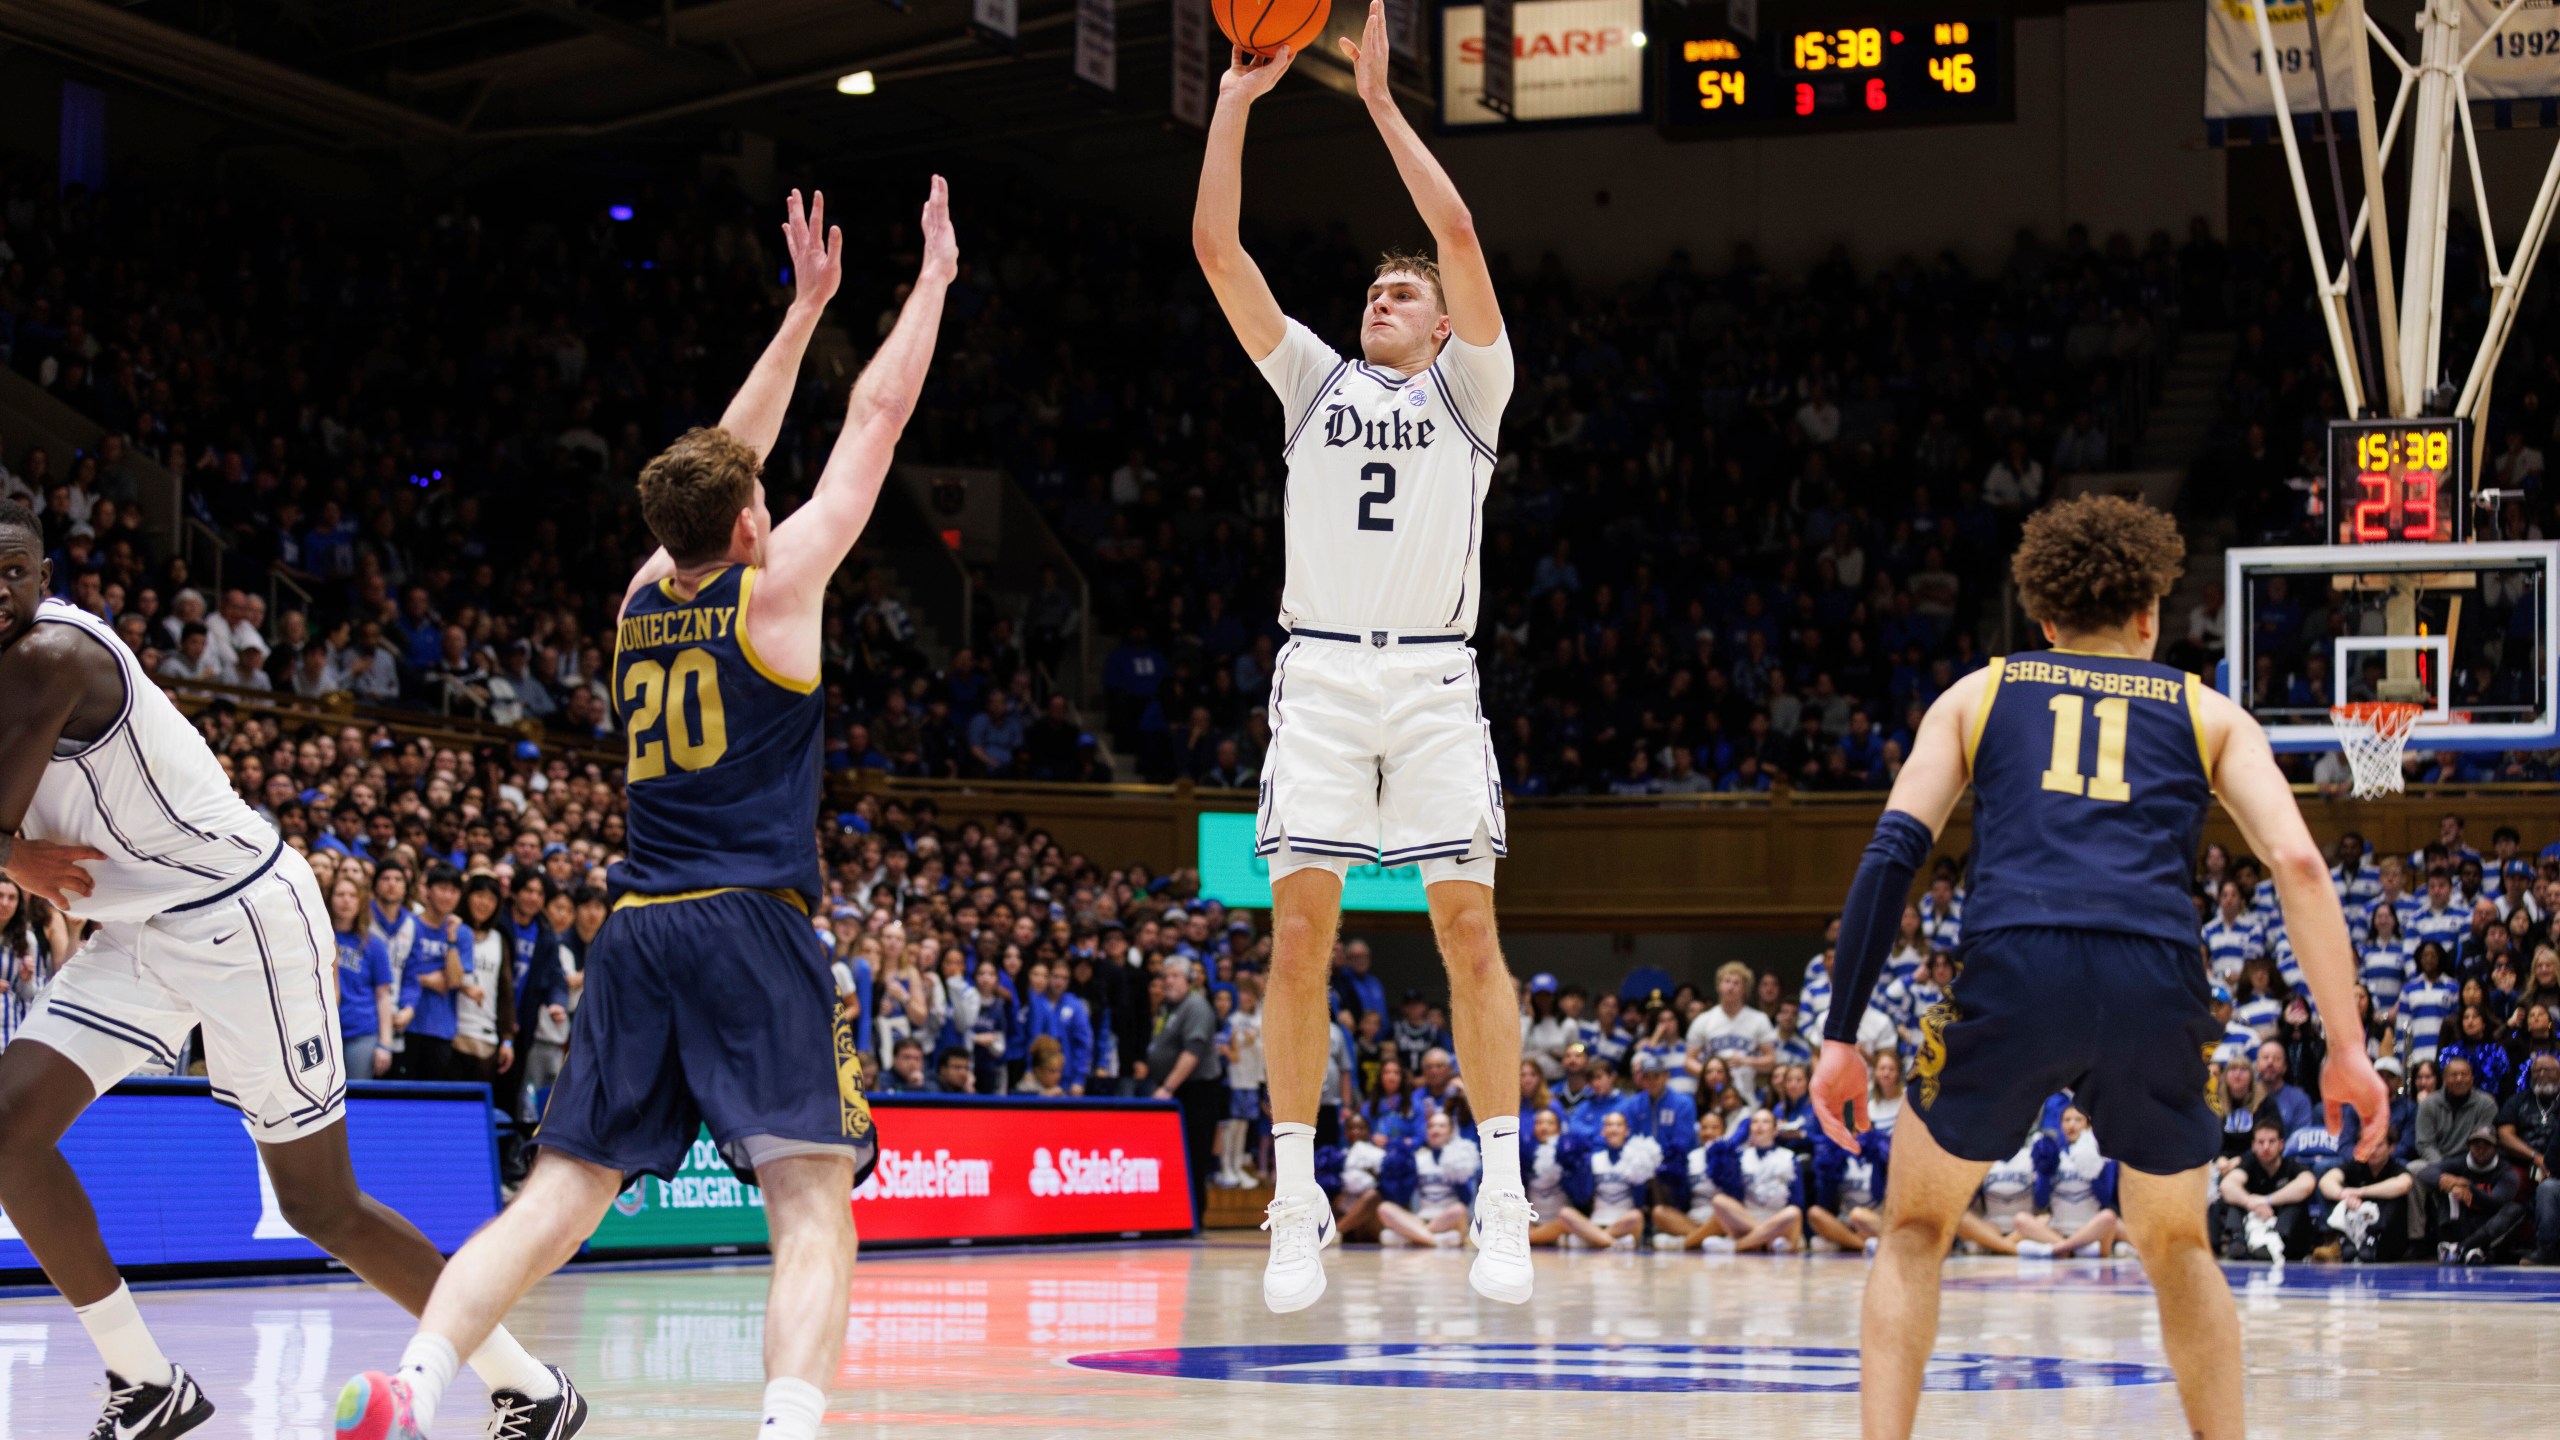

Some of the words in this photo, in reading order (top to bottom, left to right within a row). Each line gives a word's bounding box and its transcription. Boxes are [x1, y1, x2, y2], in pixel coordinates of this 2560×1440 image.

[1795, 28, 1881, 70] 15:38
[2494, 28, 2560, 57] 1992
[1698, 70, 1745, 109] 54
[1865, 78, 1887, 110] 6
[1929, 53, 1976, 93] 46
[1795, 83, 1815, 115] 3
[1324, 403, 1436, 451] Duke
[2358, 432, 2448, 471] 15:38
[1358, 462, 1396, 532] 2
[2355, 472, 2437, 540] 23
[619, 606, 736, 653] ONIECZNY
[2004, 660, 2183, 704] SHREWSBERRY
[623, 647, 728, 784] 20
[2041, 693, 2132, 803] 11
[657, 1176, 744, 1209] FREIGHT
